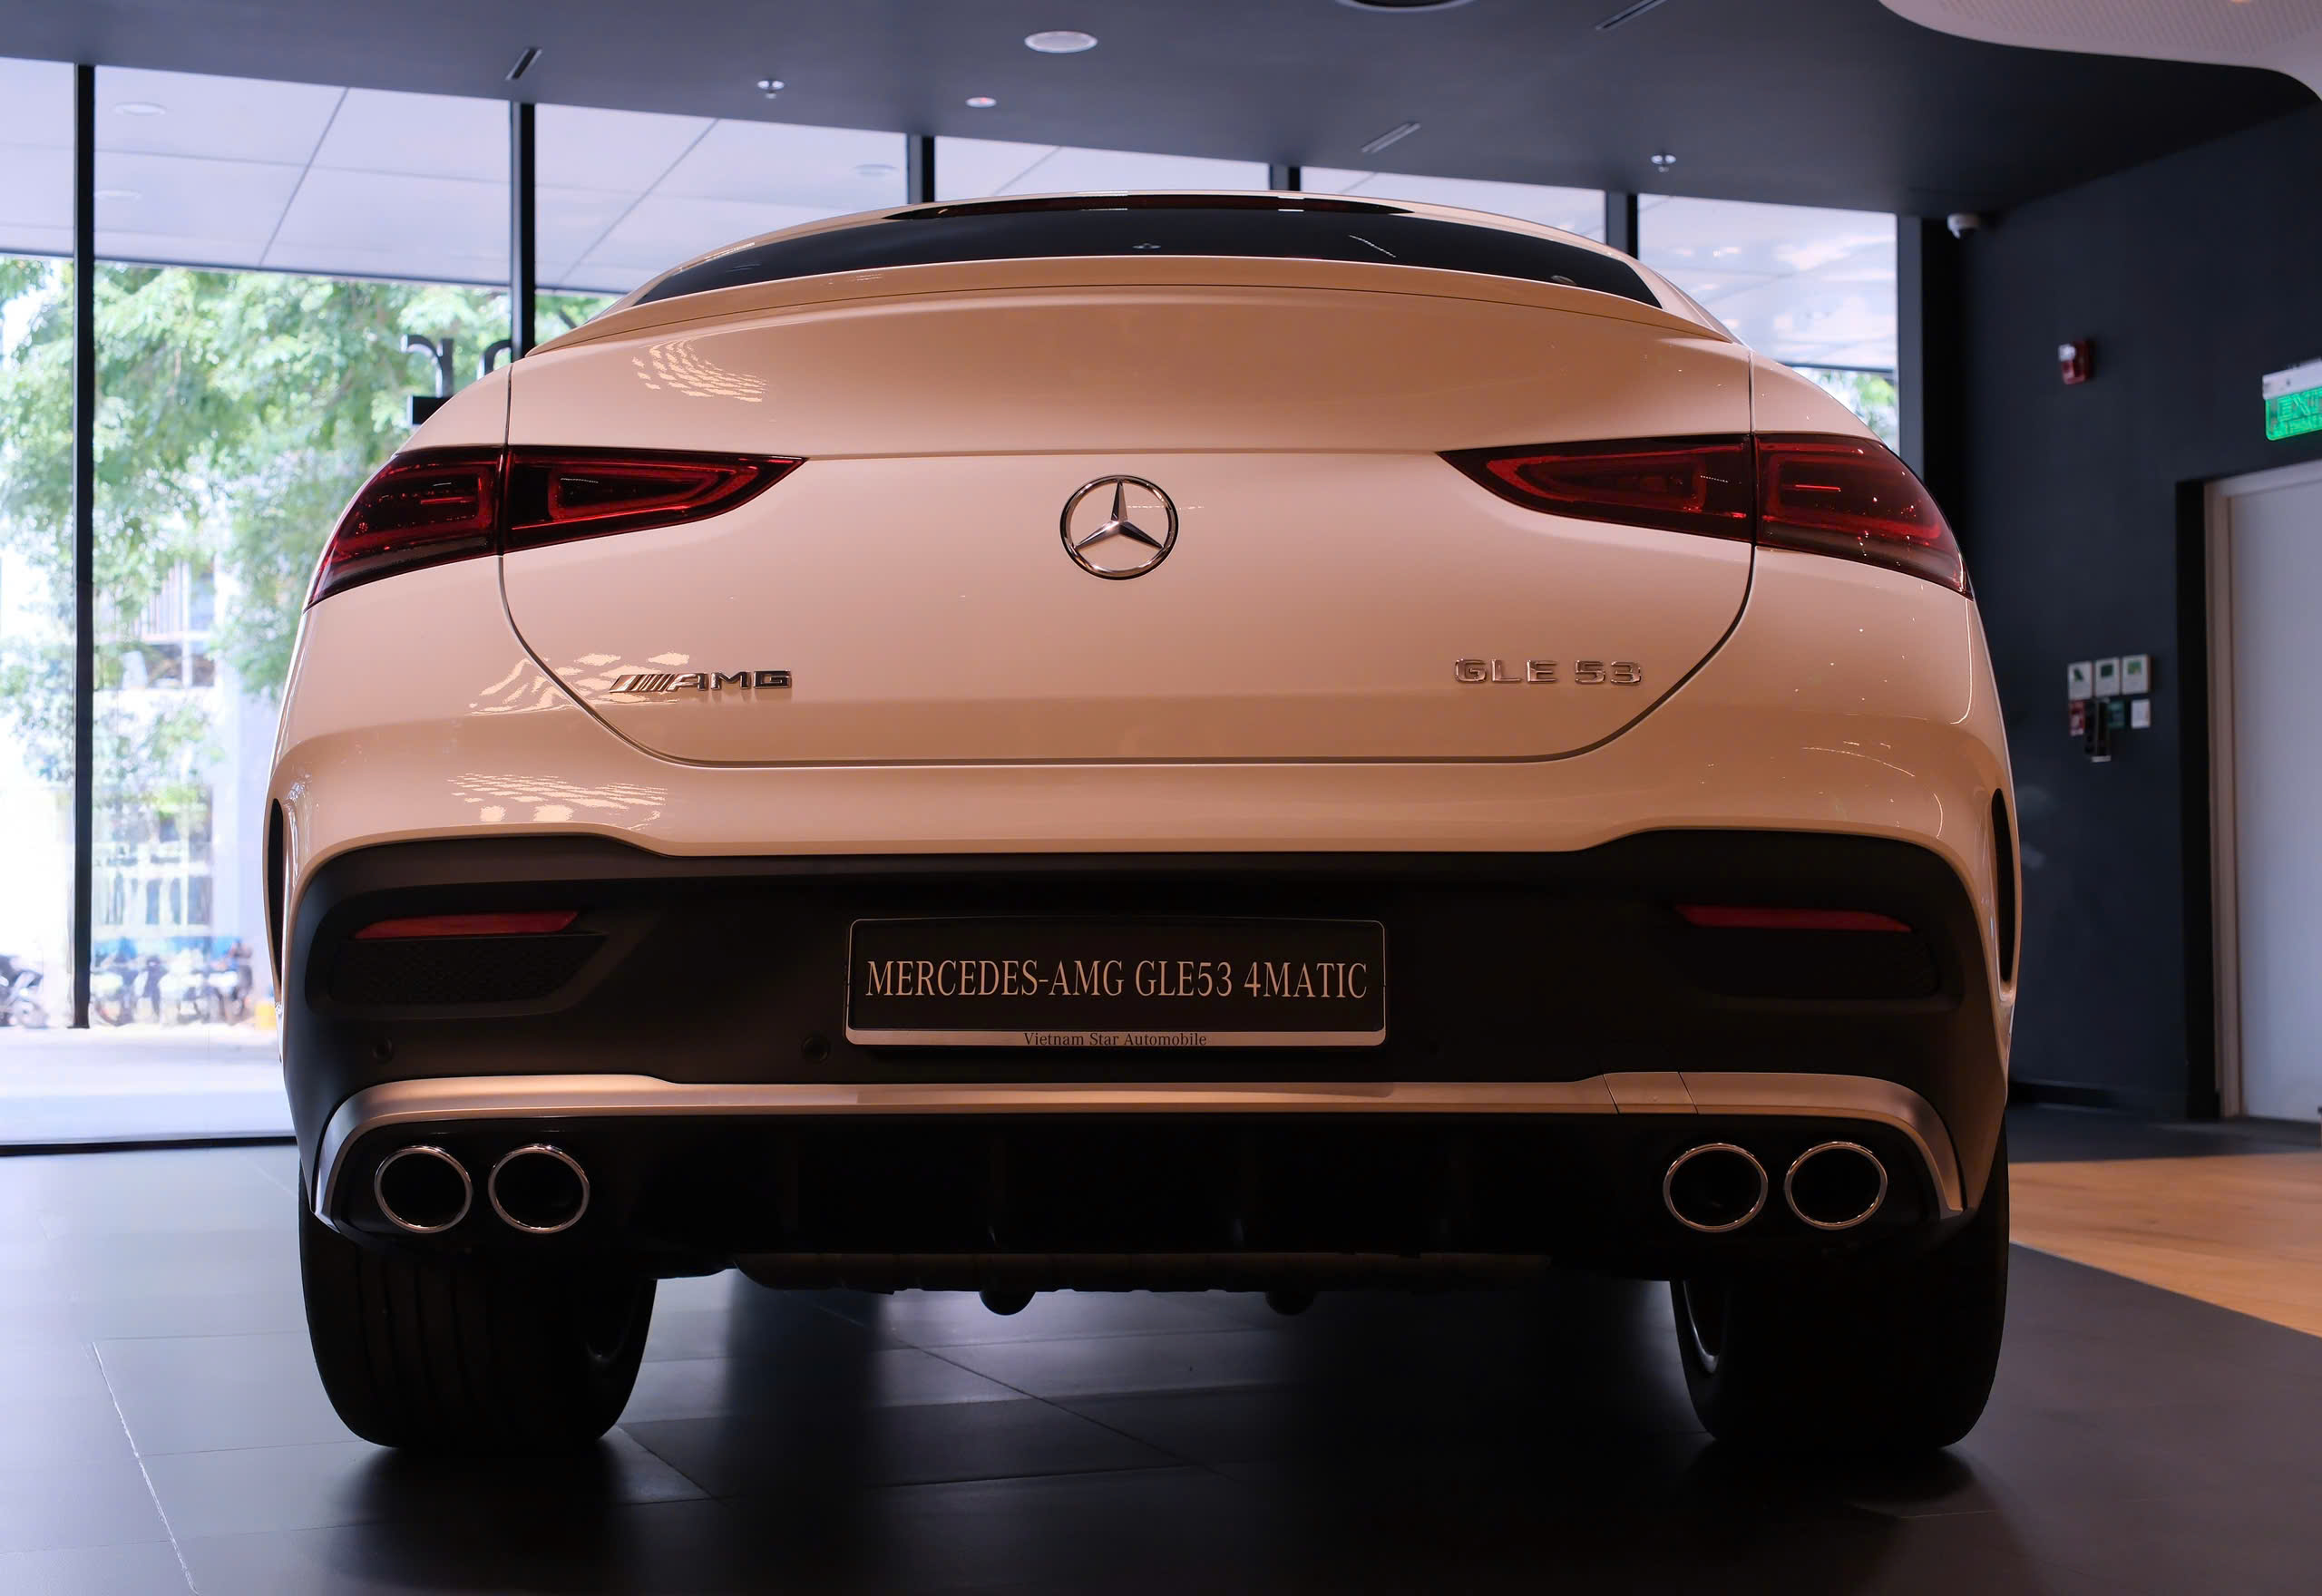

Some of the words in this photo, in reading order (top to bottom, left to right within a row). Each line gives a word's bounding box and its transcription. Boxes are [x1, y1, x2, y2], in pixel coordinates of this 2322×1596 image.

[1455, 658, 1558, 683] GLE
[1575, 659, 1641, 685] 53
[865, 959, 1126, 997] MERCEDES-AMG
[1135, 959, 1233, 998] GLE53
[1244, 961, 1368, 998] 4MATIC
[1023, 1032, 1085, 1046] Vietnam
[1089, 1032, 1119, 1046] Star
[1124, 1032, 1207, 1046] Automobile
